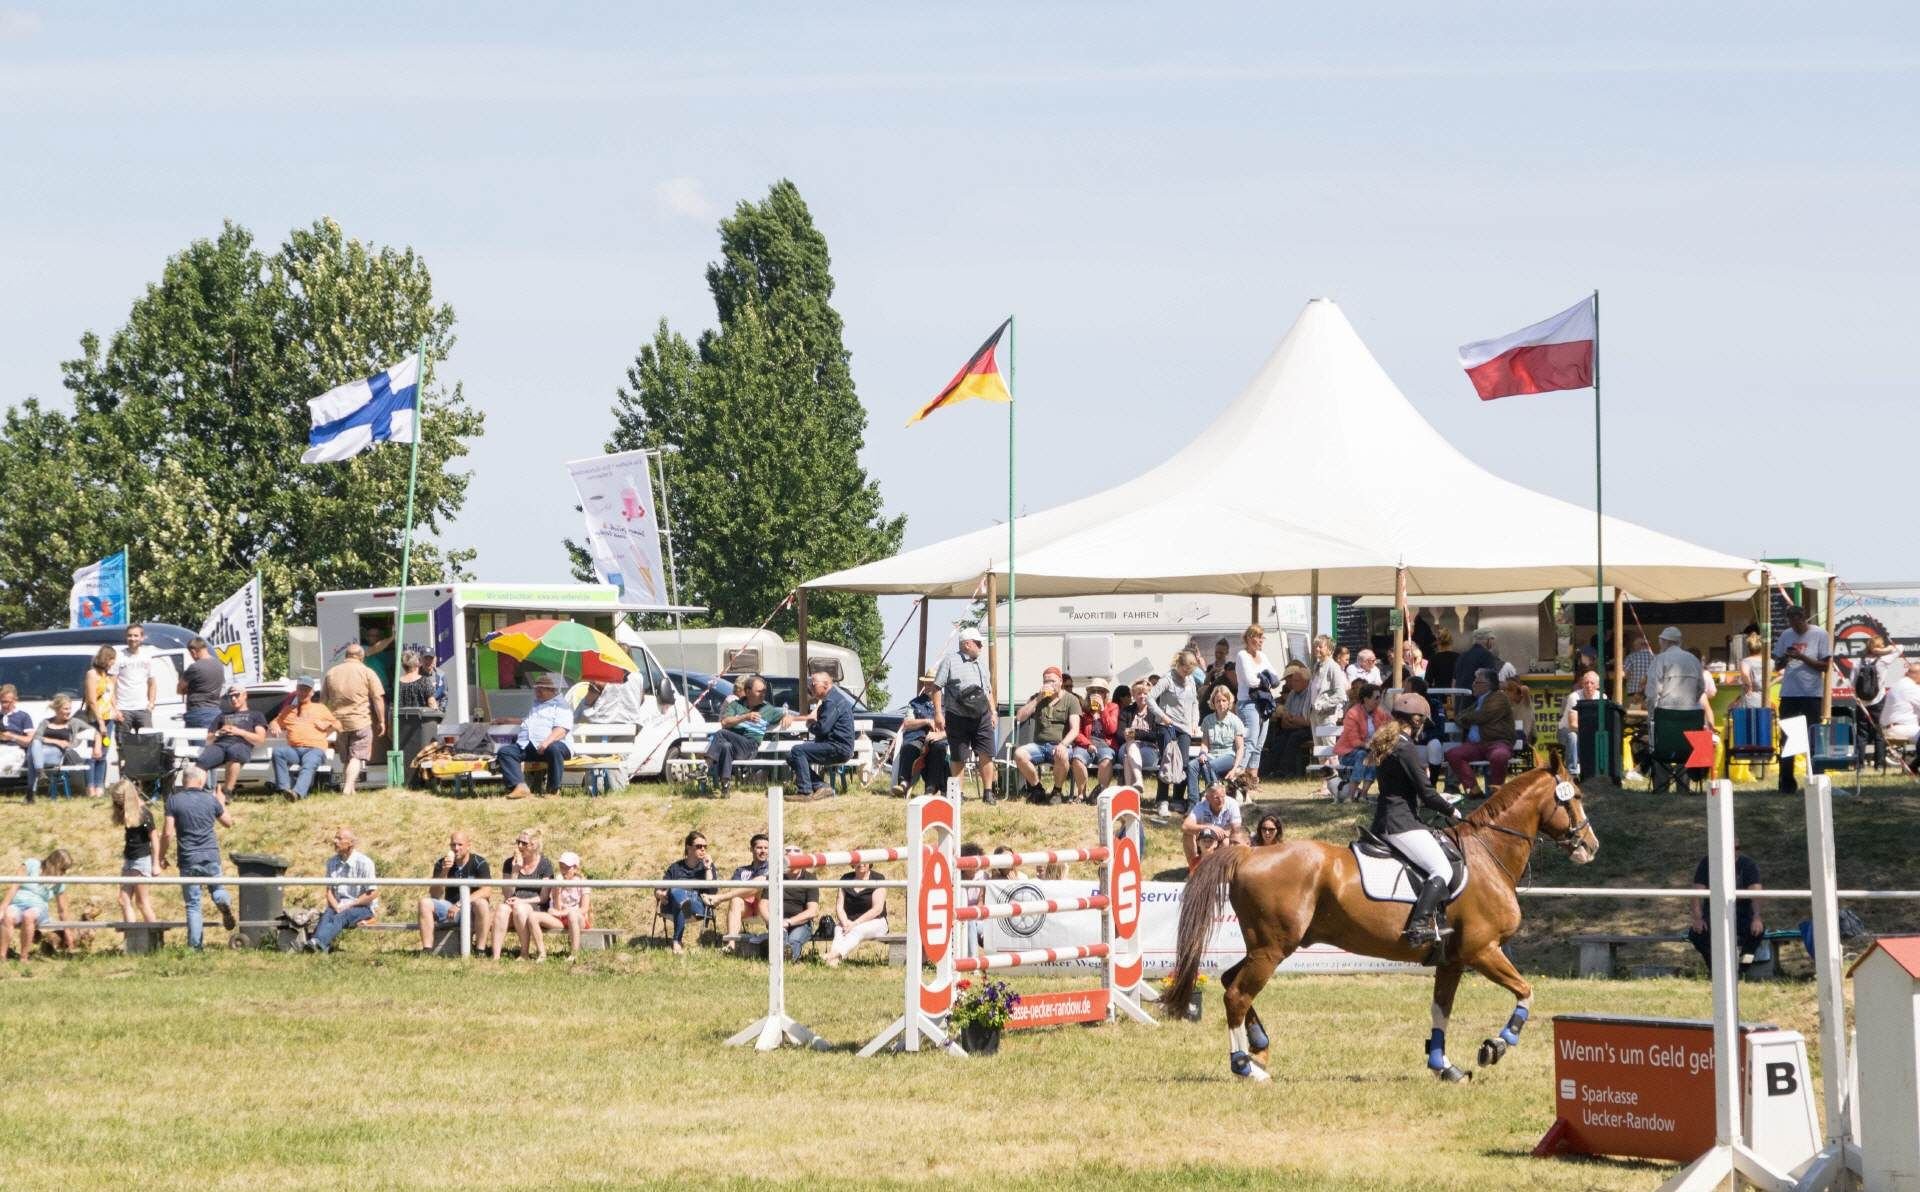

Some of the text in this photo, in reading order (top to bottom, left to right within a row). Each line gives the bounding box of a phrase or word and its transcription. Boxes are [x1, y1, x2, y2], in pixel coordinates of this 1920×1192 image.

[1123, 611, 1159, 619] FAHREN
[1560, 1039, 1716, 1075] Wenn's um Geld geh
[1766, 1061, 1797, 1097] B
[1582, 1084, 1639, 1106] Sparkasse
[1583, 1108, 1676, 1132] Uecker-Randow
